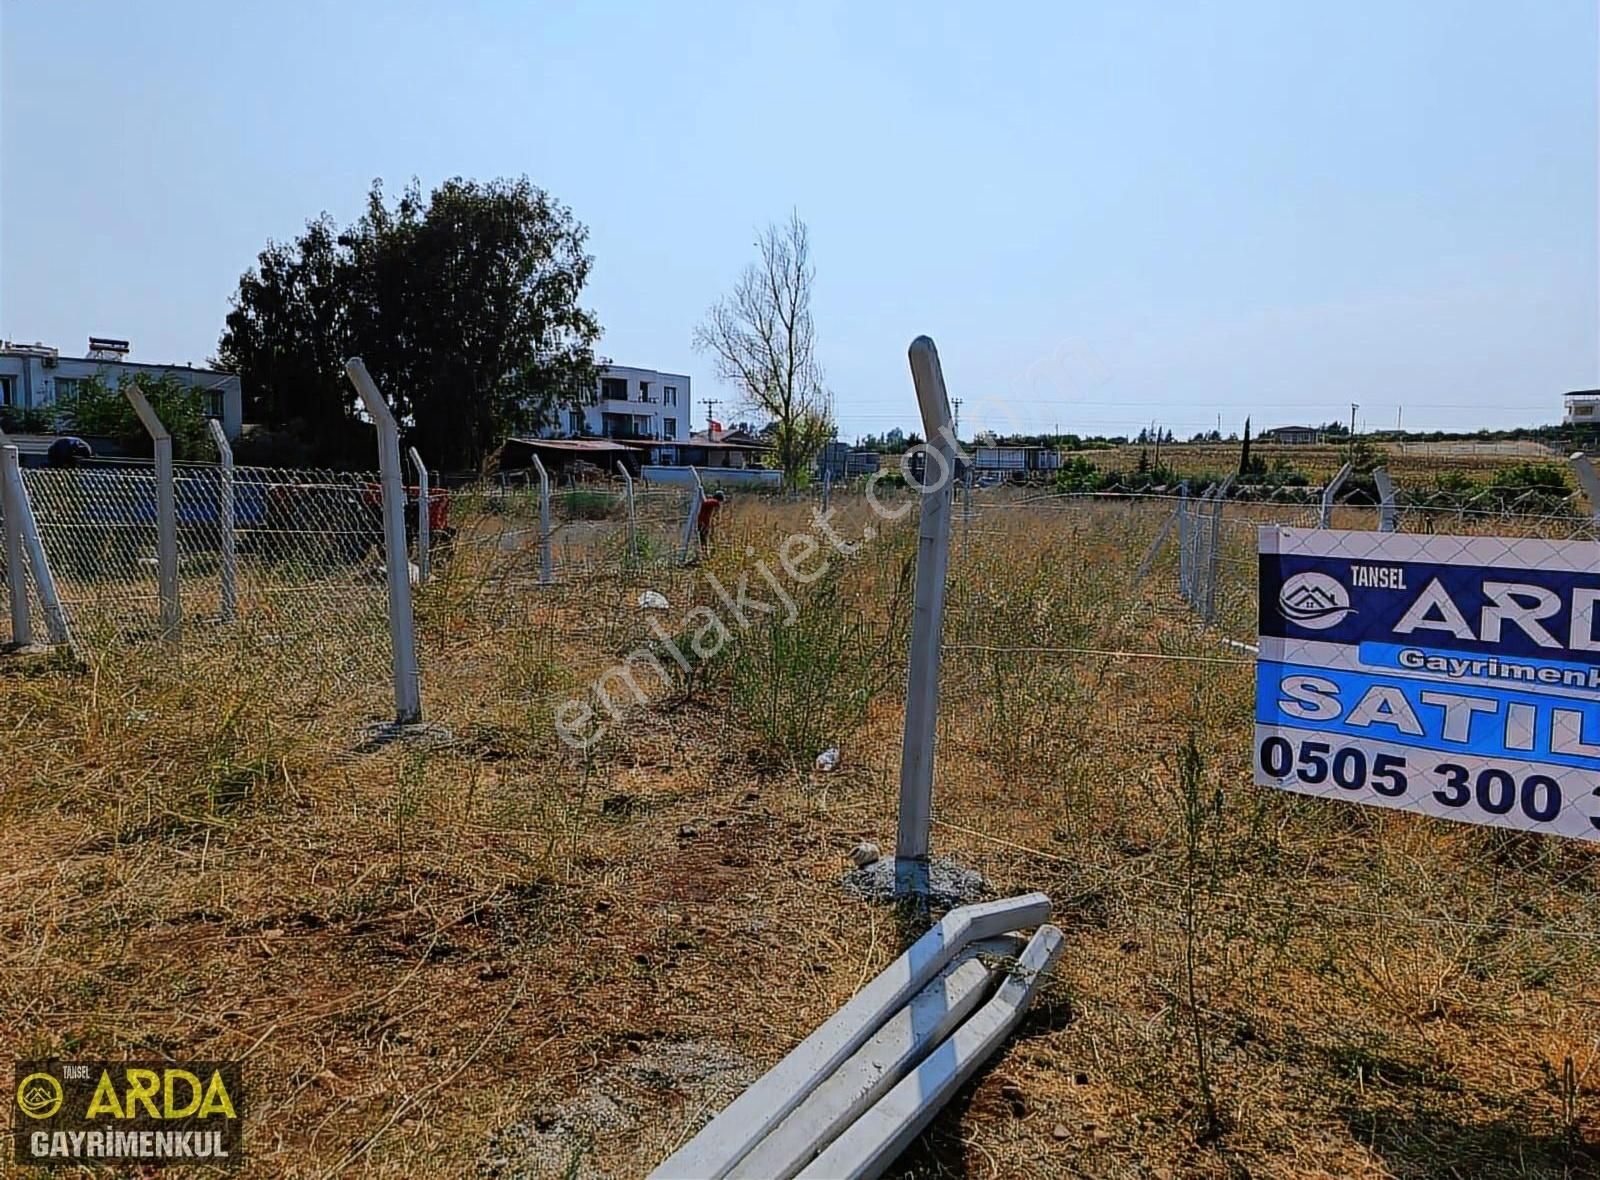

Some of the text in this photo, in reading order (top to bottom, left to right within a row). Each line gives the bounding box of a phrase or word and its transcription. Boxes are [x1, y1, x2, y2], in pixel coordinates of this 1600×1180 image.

[1350, 565, 1407, 590] TANSEL
[1259, 736, 1408, 797] 0505
[1432, 763, 1562, 822] 300
